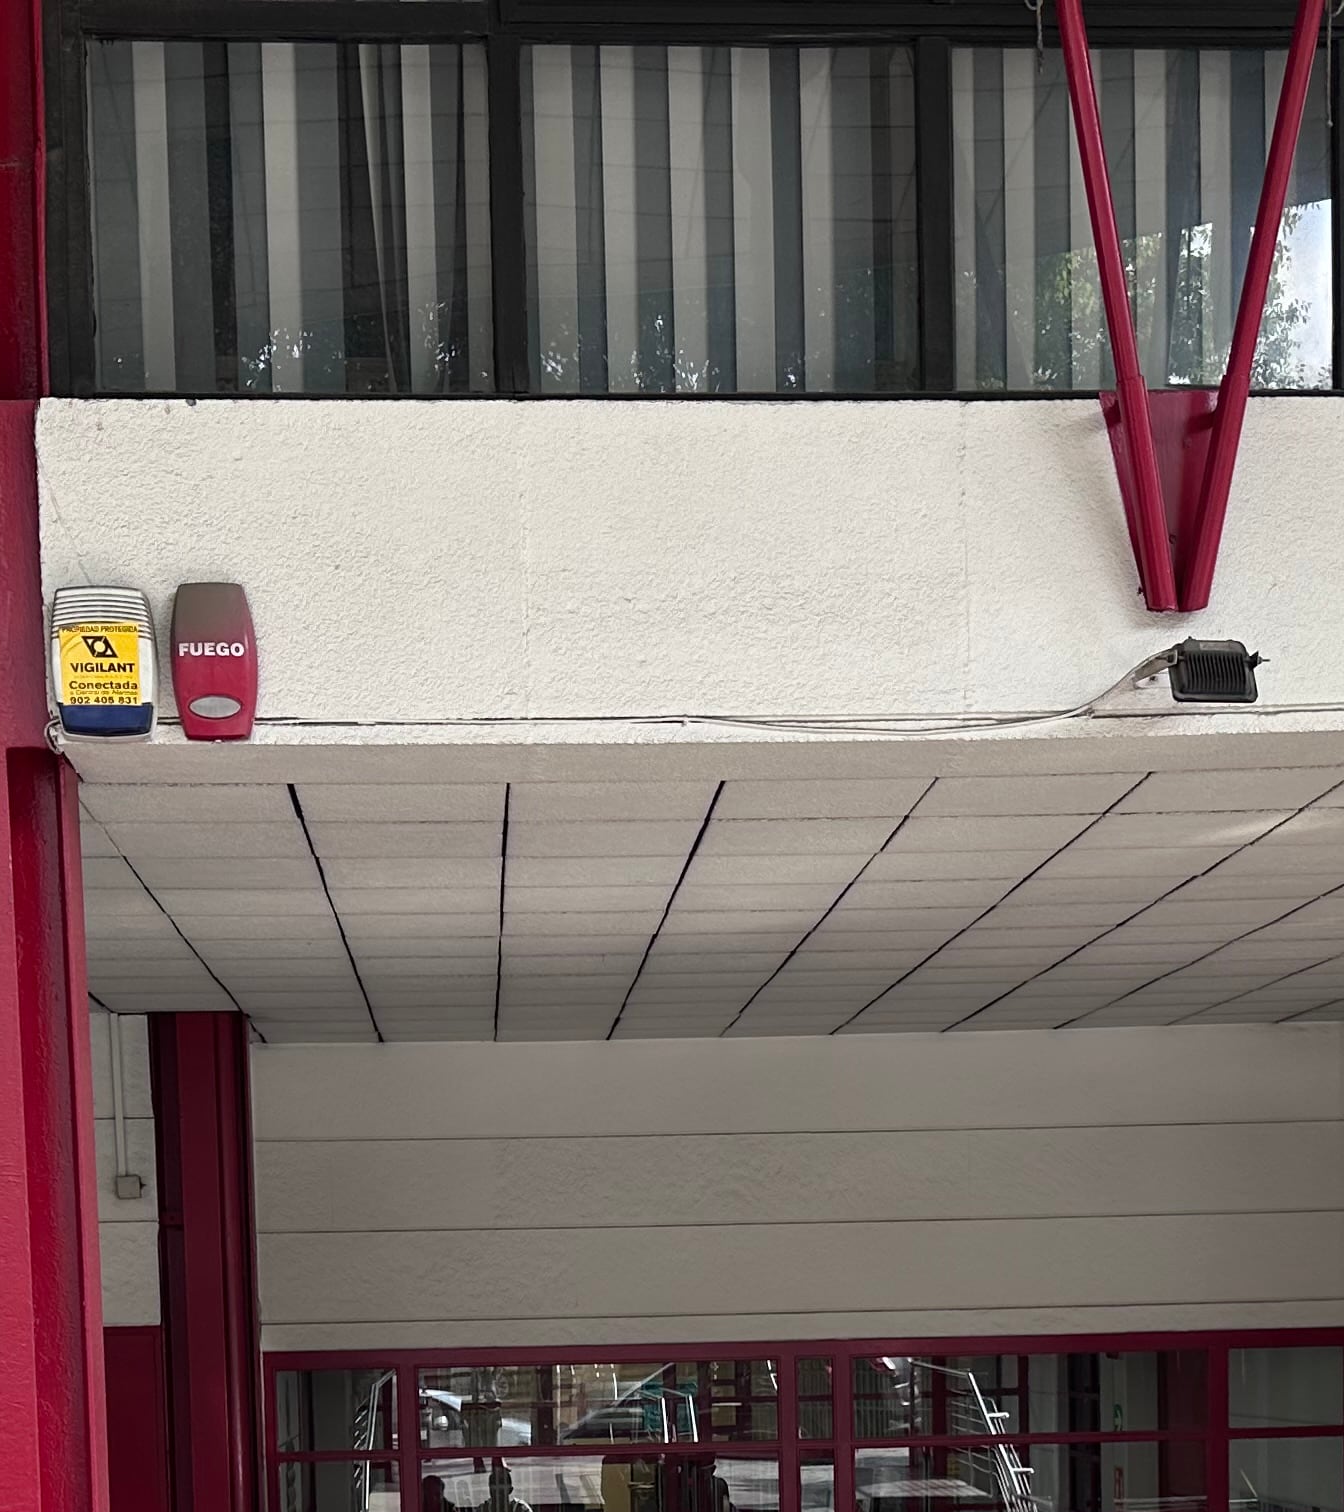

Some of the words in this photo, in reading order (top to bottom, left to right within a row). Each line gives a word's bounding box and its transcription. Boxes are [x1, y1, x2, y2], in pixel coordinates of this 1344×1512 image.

[178, 642, 245, 657] FUEGO
[70, 662, 135, 673] VIGILANT
[69, 680, 138, 690] Conectada
